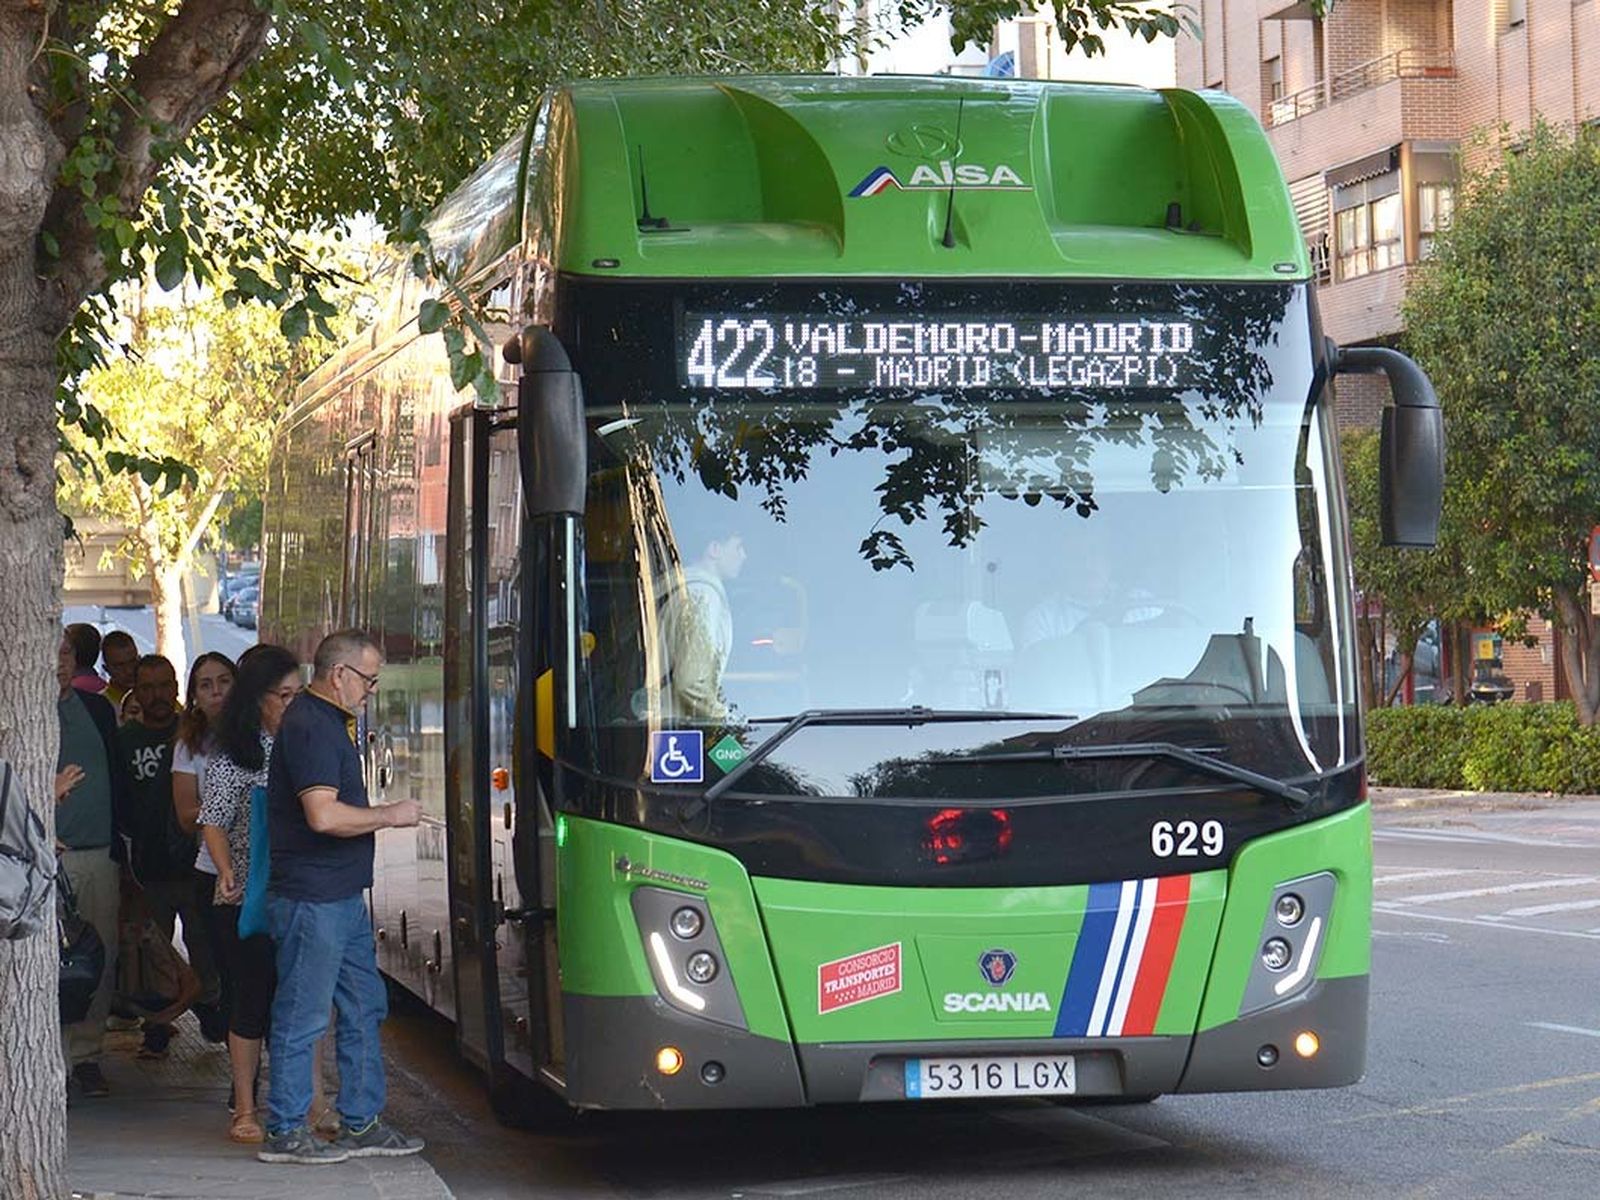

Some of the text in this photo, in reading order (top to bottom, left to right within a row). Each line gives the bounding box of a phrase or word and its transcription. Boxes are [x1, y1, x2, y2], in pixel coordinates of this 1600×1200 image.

[785, 322, 1194, 353] VALDEMORO-MADRID
[687, 319, 775, 387] 422
[875, 356, 991, 387] MADRID
[716, 749, 742, 760] GNC
[1151, 820, 1224, 857] 629
[838, 948, 896, 976] CONSORCIO
[823, 963, 896, 994] TRANSPORTES
[857, 976, 896, 998] MADRID
[943, 992, 1051, 1013] SCANIA
[928, 1063, 1003, 1091] 5316
[1014, 1061, 1069, 1088] LGX
